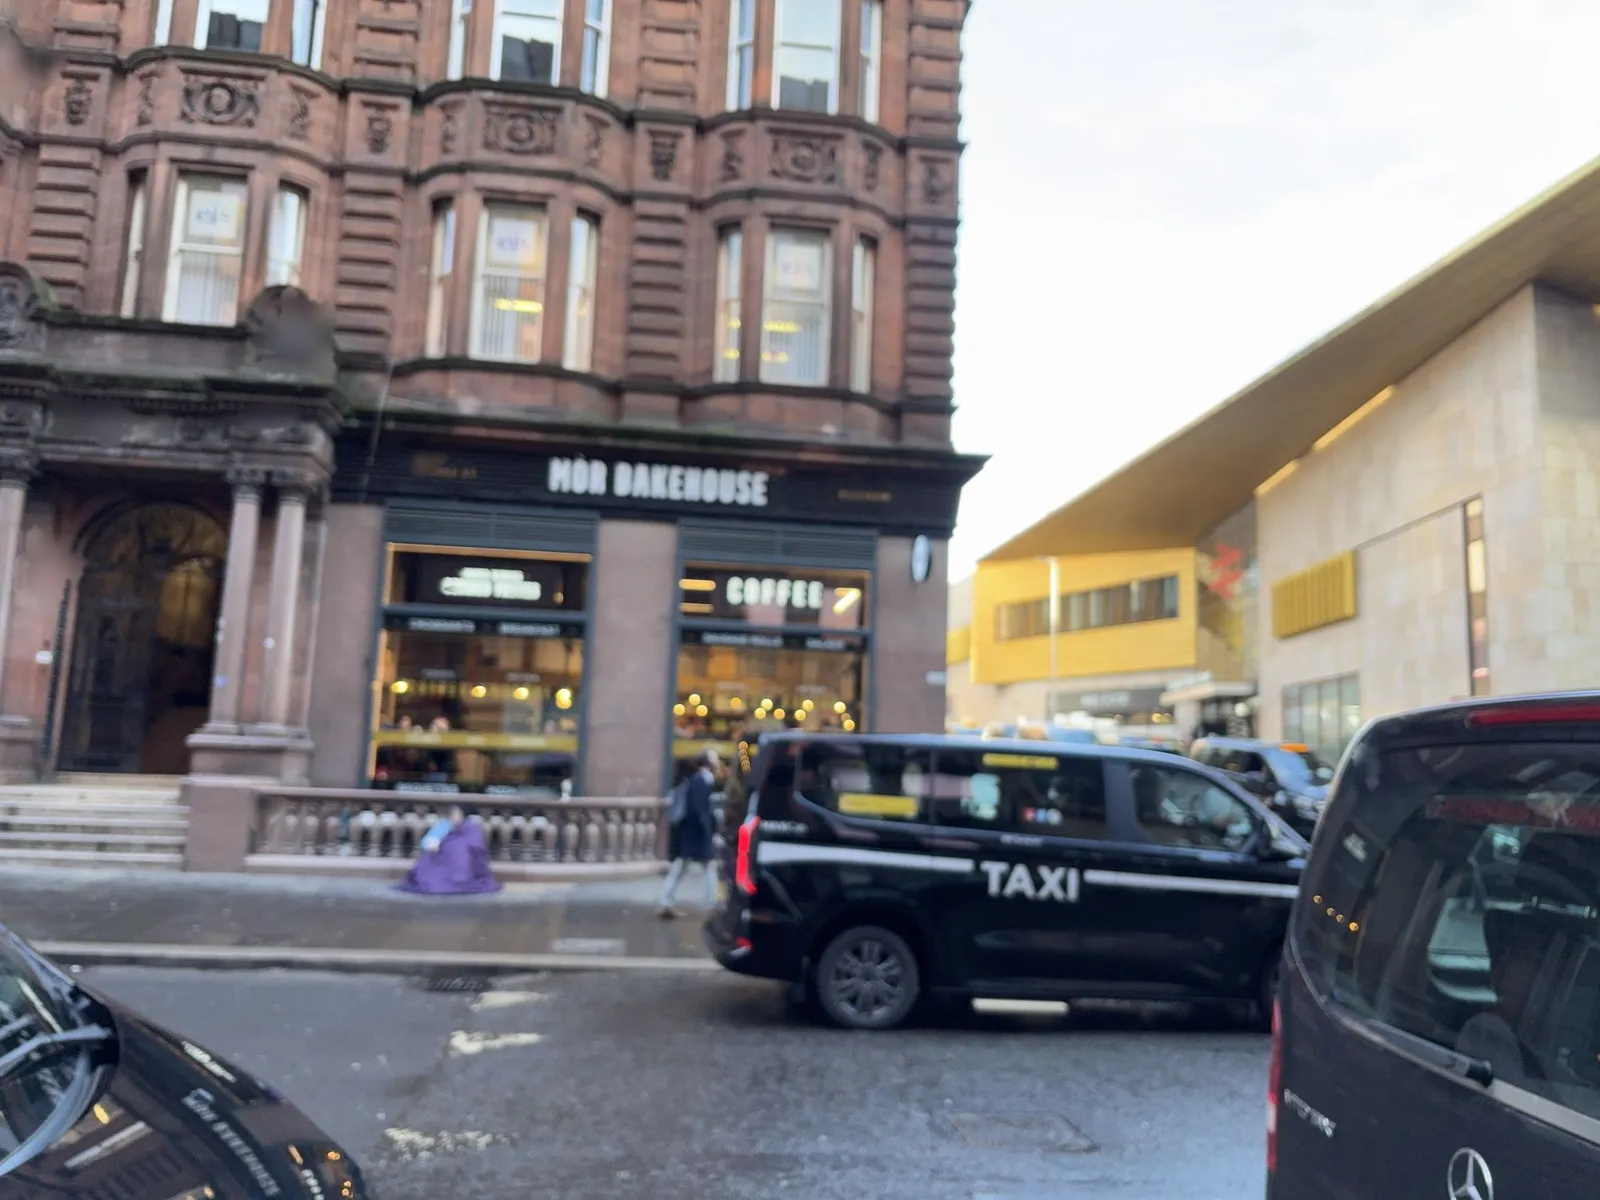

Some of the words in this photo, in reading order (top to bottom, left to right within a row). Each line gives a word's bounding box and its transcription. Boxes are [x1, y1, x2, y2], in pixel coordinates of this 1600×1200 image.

[613, 461, 769, 506] BAKEHOUSE
[726, 576, 824, 609] COFFEE
[980, 860, 1080, 903] TAXI
